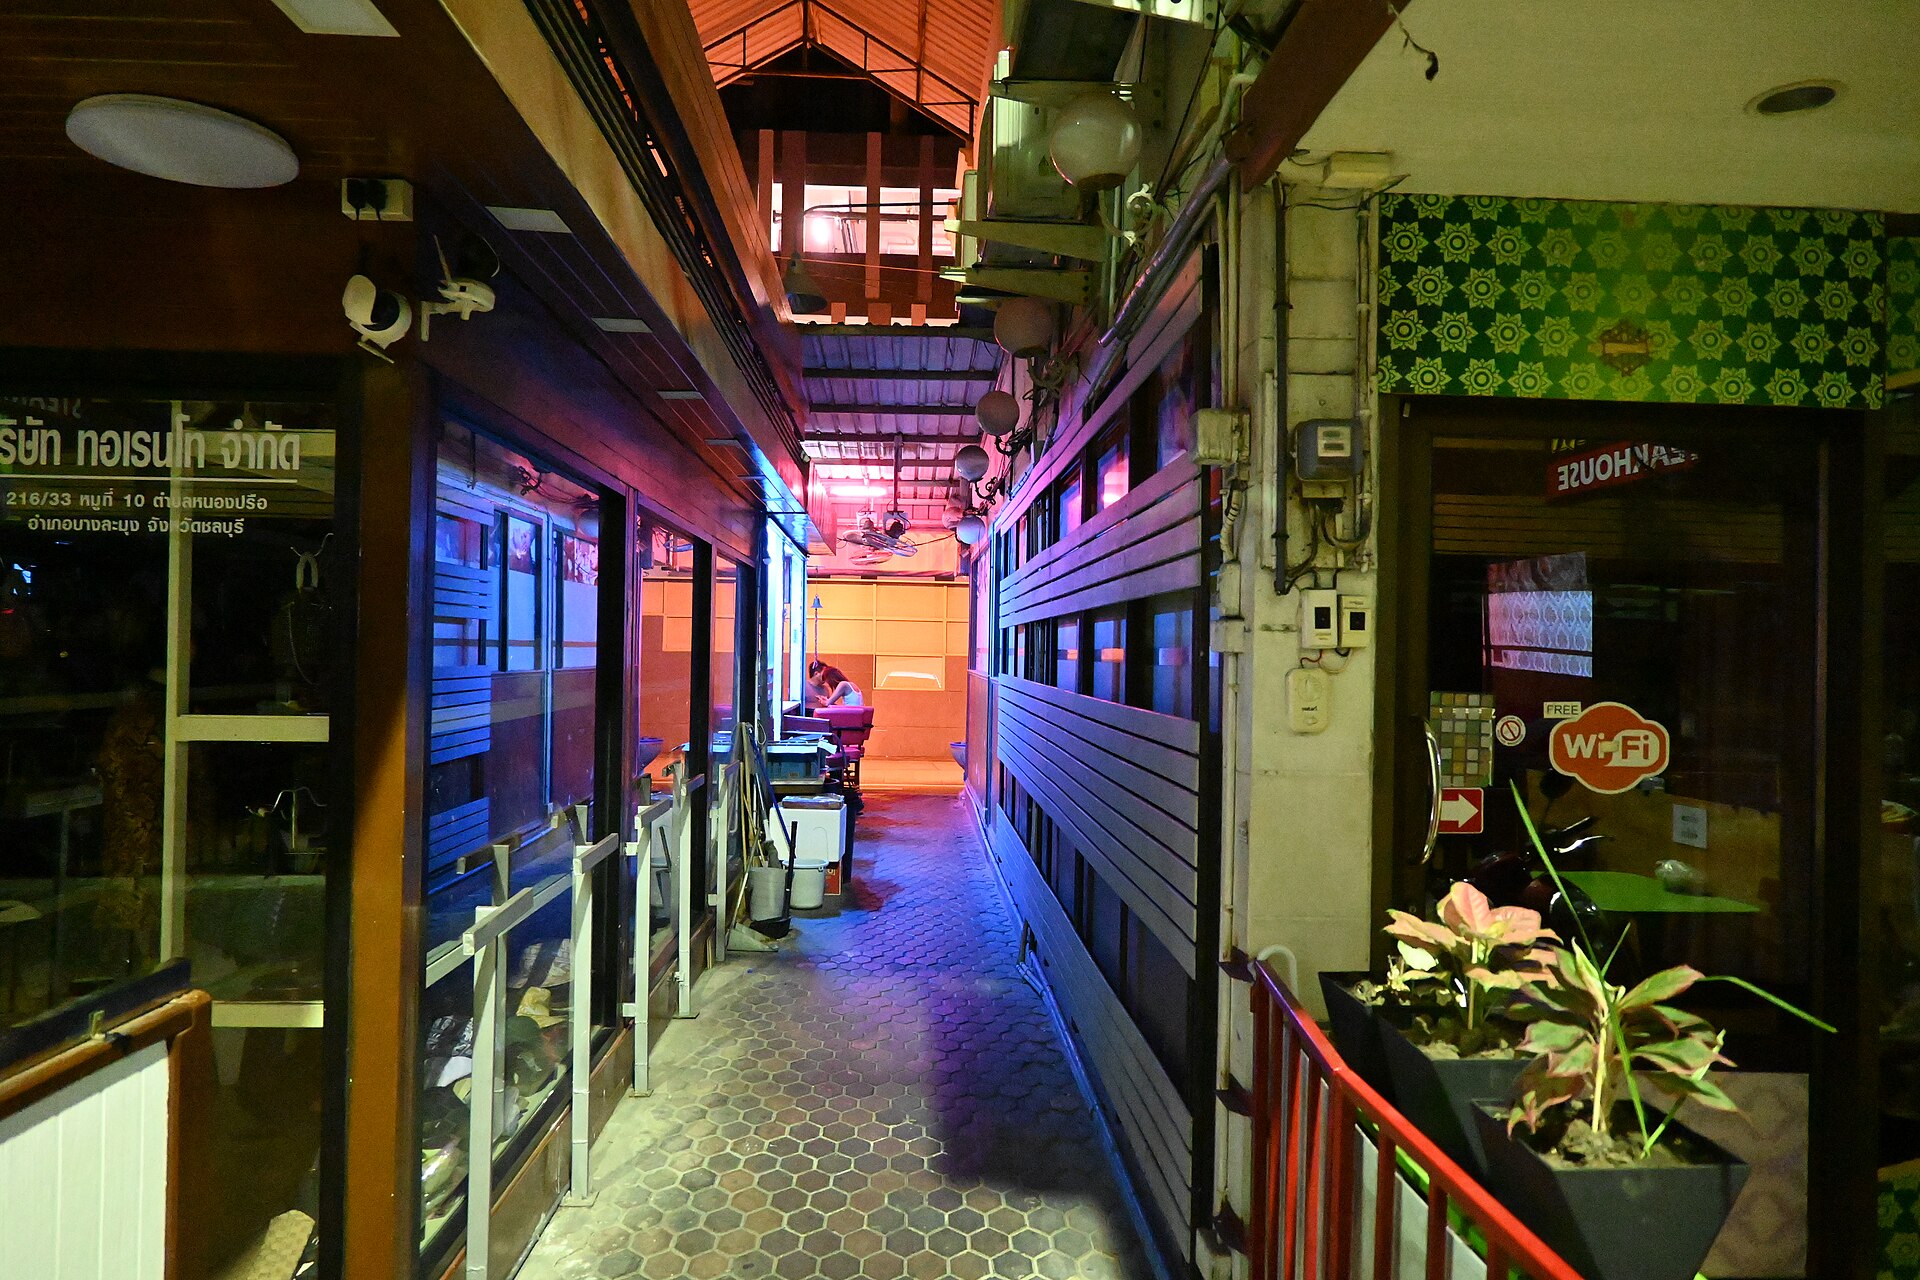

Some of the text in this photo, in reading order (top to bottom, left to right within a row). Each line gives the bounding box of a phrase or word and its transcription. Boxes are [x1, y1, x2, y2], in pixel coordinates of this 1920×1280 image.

[221, 418, 301, 471] จำกัด
[6, 491, 72, 507] 216/33
[123, 493, 145, 508] 10
[28, 514, 245, 538] อำเภอบางละมุง จังวัดชลบุรี
[1546, 704, 1579, 716] FREE
